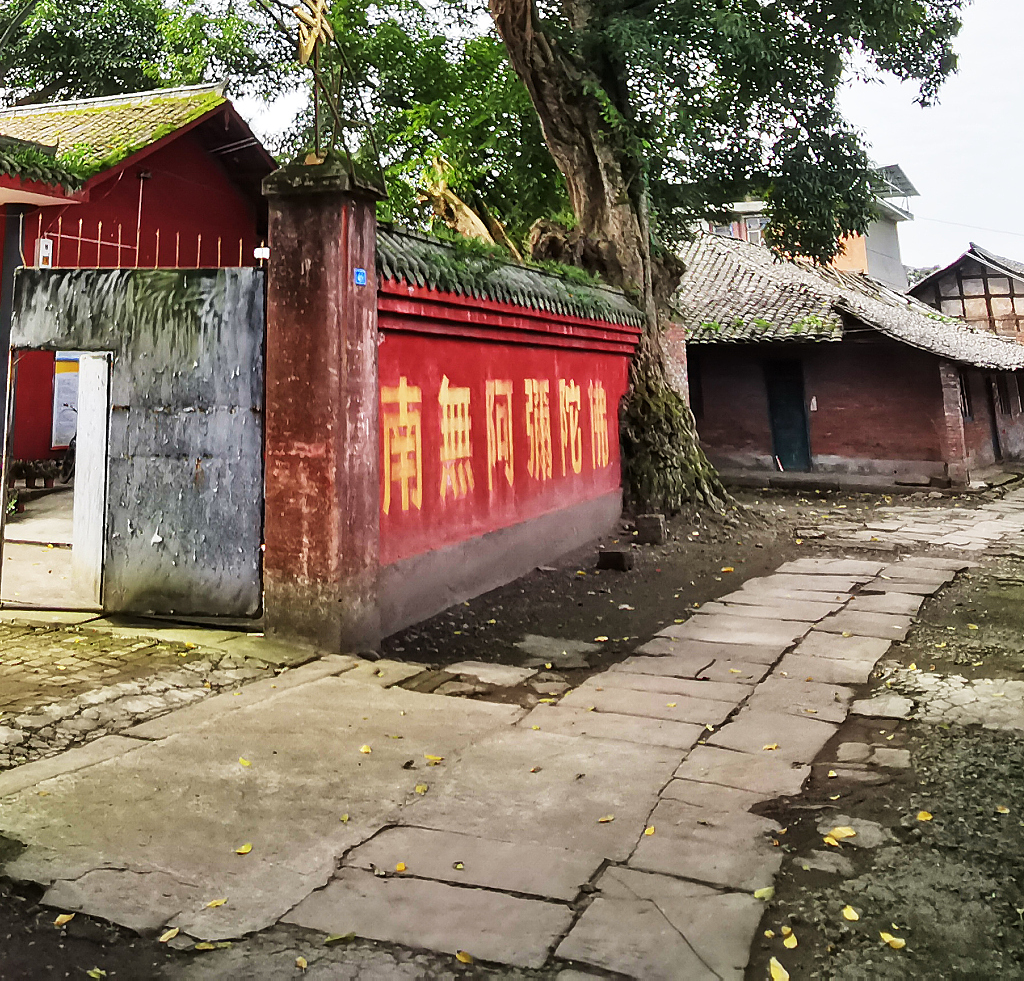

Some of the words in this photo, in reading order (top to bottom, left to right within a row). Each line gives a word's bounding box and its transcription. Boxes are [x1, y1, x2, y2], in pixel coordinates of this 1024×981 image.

[380, 374, 609, 516] 南無阿彌陀佛
